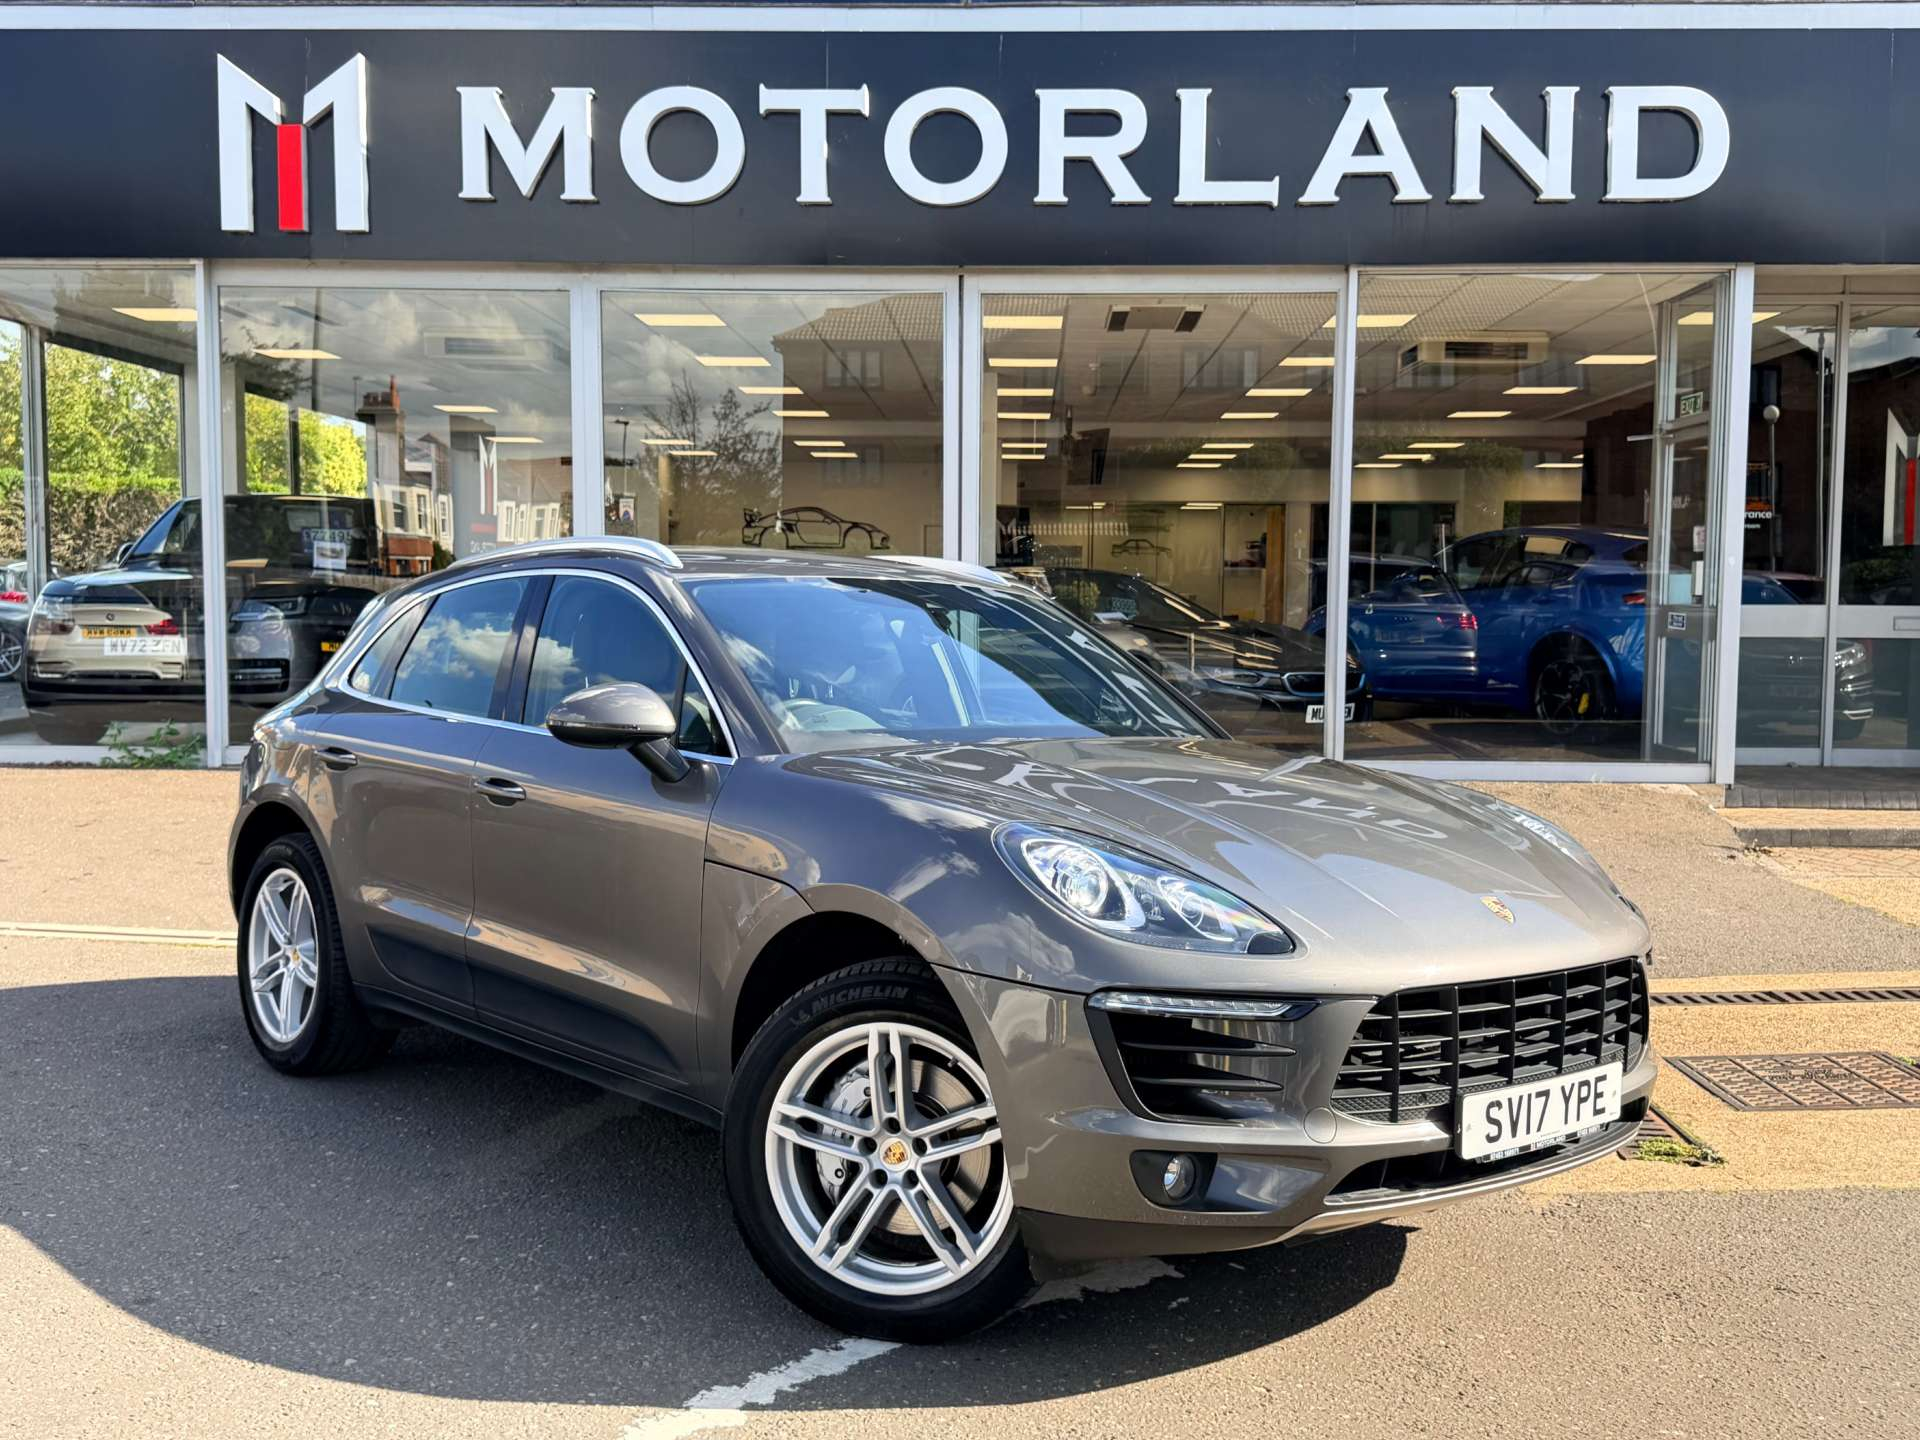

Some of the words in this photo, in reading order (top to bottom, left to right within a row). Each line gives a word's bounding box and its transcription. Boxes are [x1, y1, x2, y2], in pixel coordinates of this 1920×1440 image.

[457, 85, 1731, 206] MOTORLAND
[1744, 511, 1773, 519] rance
[811, 985, 910, 1013] MICHELIN
[1485, 1089, 1550, 1143] SV17
[1560, 1074, 1608, 1126] YPE
